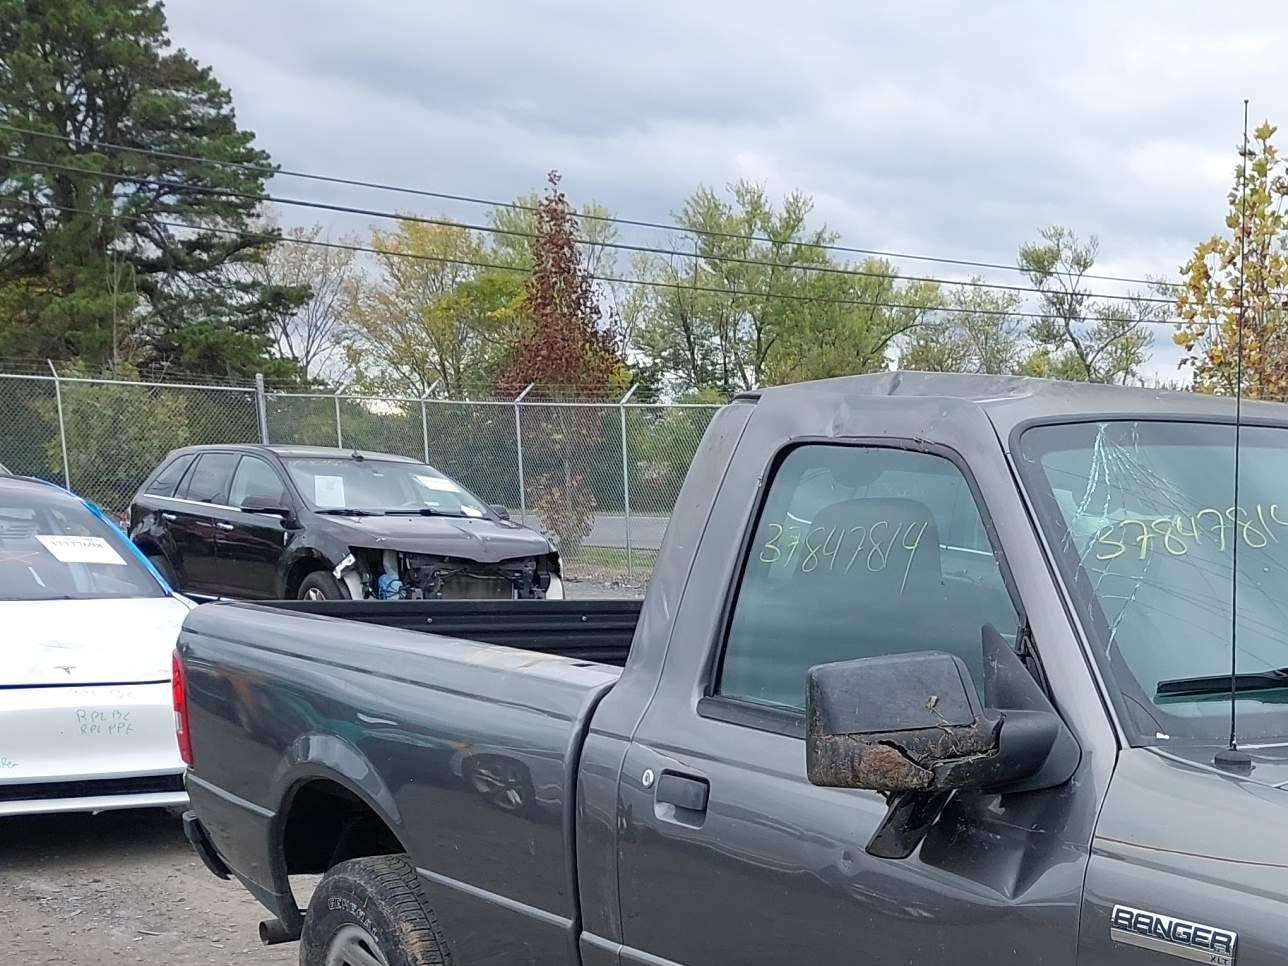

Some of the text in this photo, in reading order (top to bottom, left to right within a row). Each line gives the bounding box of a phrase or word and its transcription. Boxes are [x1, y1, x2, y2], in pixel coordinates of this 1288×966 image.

[759, 520, 928, 593] 37847814
[1113, 908, 1233, 955] RANGER
[1209, 954, 1229, 966] XLT
